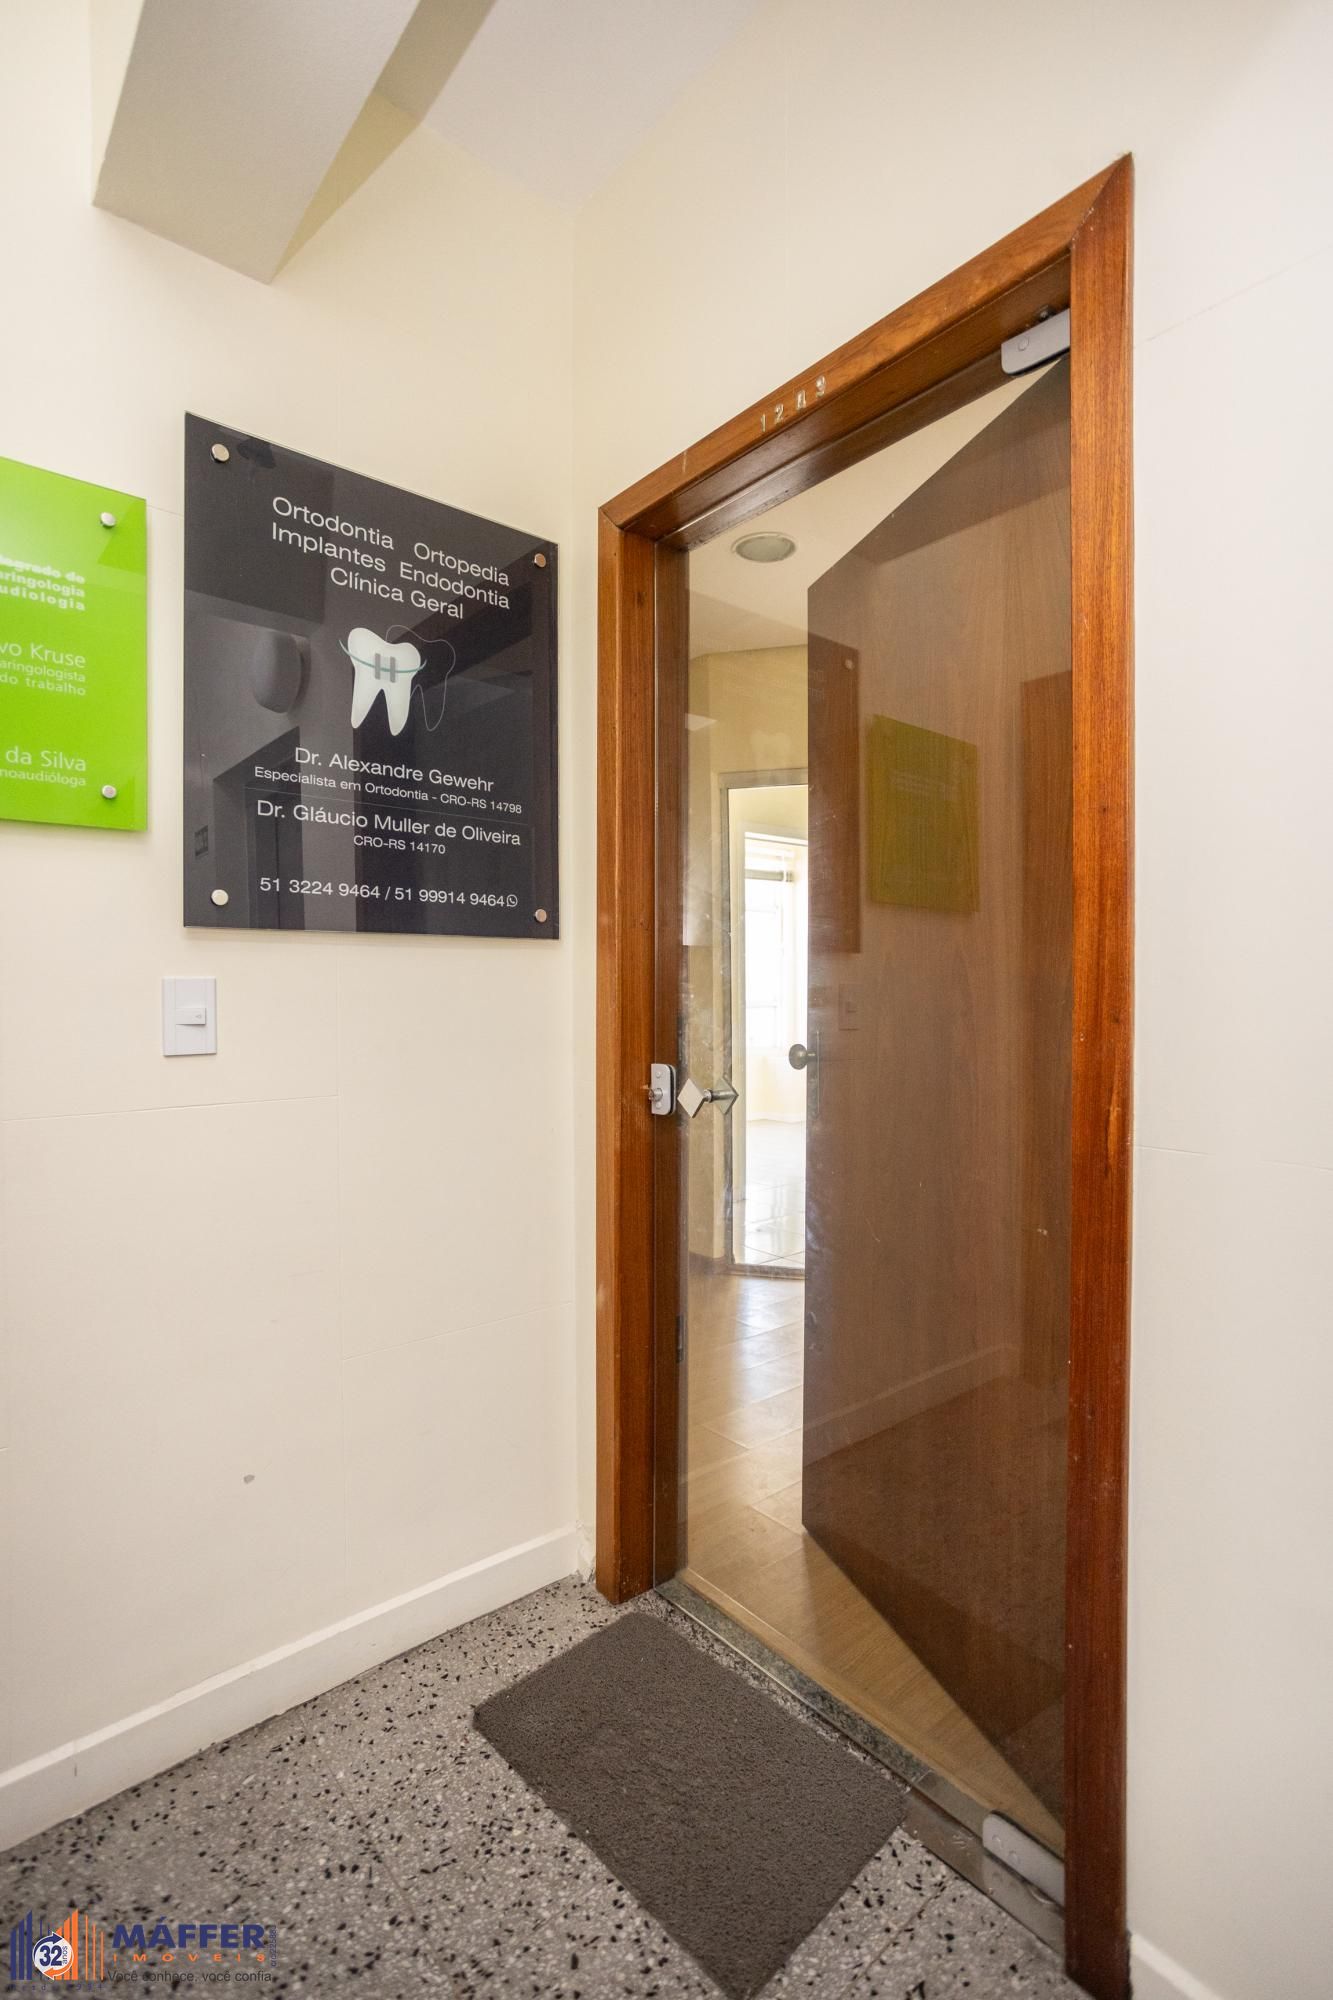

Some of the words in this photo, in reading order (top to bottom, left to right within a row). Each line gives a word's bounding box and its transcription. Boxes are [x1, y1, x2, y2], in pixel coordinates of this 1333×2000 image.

[272, 496, 394, 550] Ortodontia
[414, 542, 509, 586] Ortopedia
[272, 522, 386, 572] Implantes
[400, 561, 510, 609] Endodontia
[330, 567, 404, 602] Clínica
[410, 591, 463, 619] Geral
[30, 642, 86, 668] Kruse
[25, 677, 86, 695] trabalho
[6, 745, 32, 765] da
[41, 750, 86, 771] Silva
[295, 747, 322, 766] Dr.
[329, 753, 423, 781] Alexandre
[429, 769, 494, 792] Gewehr
[254, 766, 336, 788] Especialista
[340, 780, 361, 791] em
[365, 783, 429, 801] Ortodontia
[440, 793, 487, 809] CRO-RS
[490, 801, 522, 814] 14798
[257, 800, 286, 818] Dr.
[293, 804, 368, 828] Gláucio
[374, 814, 430, 835] Muller
[434, 822, 457, 838] de
[462, 825, 521, 846] Oliveira
[353, 835, 406, 850] CRO-RS
[409, 841, 446, 854] 14170
[259, 877, 281, 892] 51
[289, 879, 333, 895] 3224
[338, 883, 380, 898] 9464
[394, 887, 413, 900] 51
[419, 890, 465, 905] 99914
[470, 892, 505, 907] 9464
